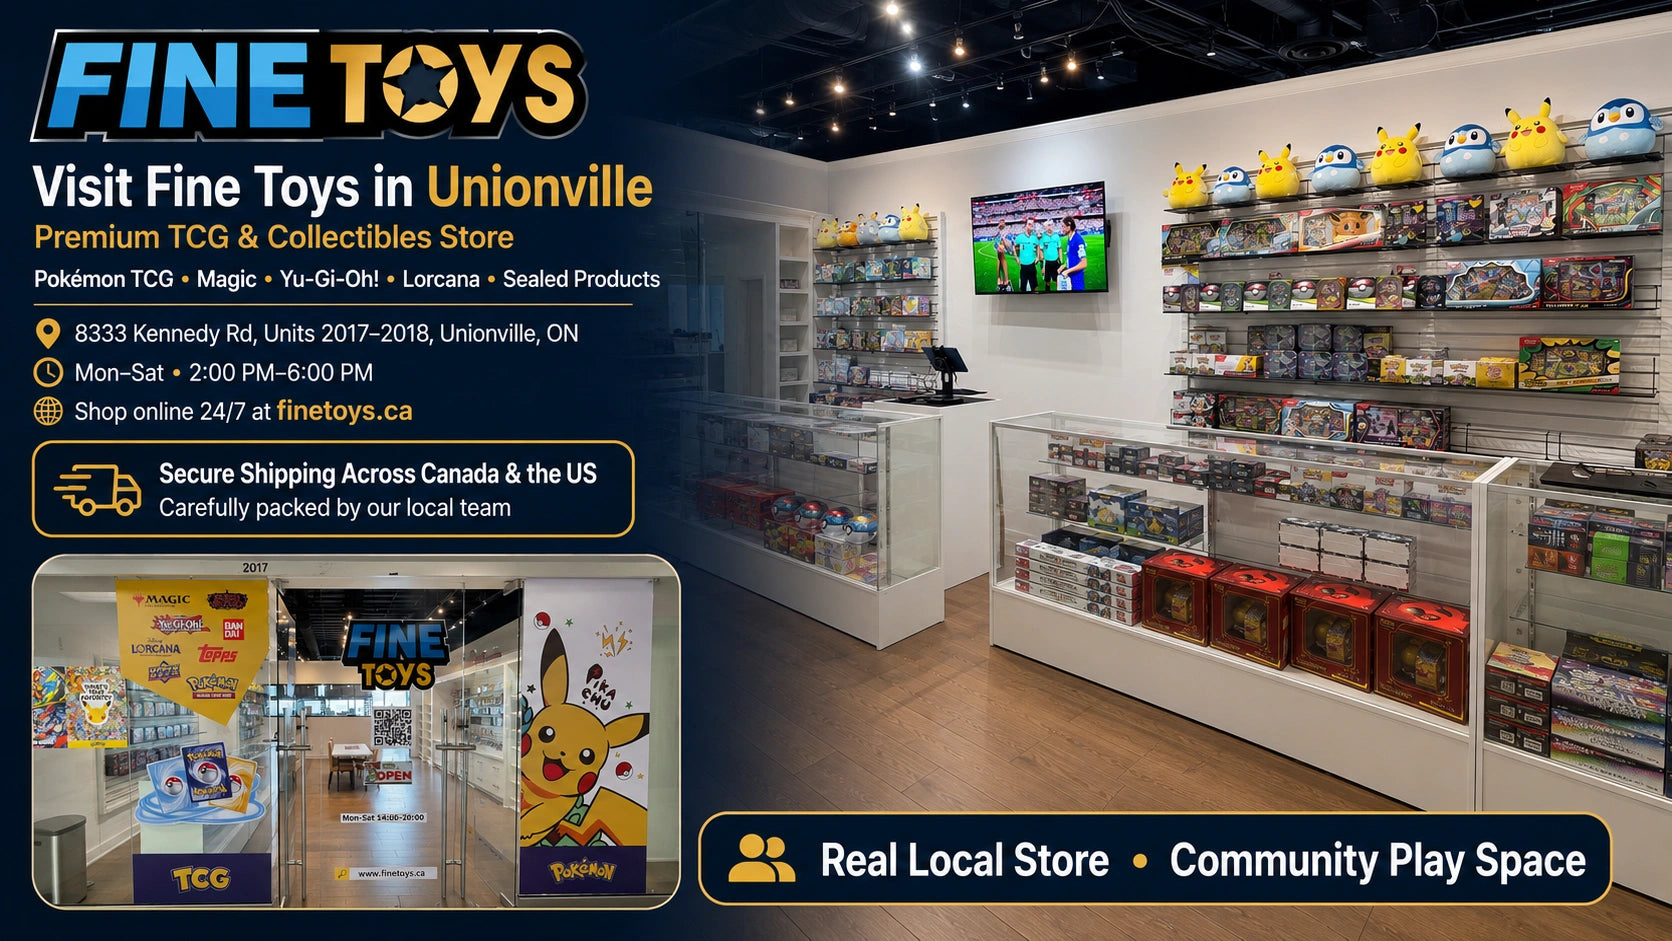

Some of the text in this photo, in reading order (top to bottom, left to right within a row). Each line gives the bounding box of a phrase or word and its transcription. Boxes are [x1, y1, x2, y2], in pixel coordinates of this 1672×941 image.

[242, 562, 269, 573] 2017
[145, 594, 191, 604] MAGIC
[347, 623, 445, 659] FINE
[131, 643, 181, 655] LORCANA
[361, 662, 433, 688] TOYS
[376, 770, 412, 781] OPEN
[342, 814, 375, 822] Mon-Sat
[358, 869, 426, 878] www.finetoys.ca
[172, 866, 232, 895] TCG
